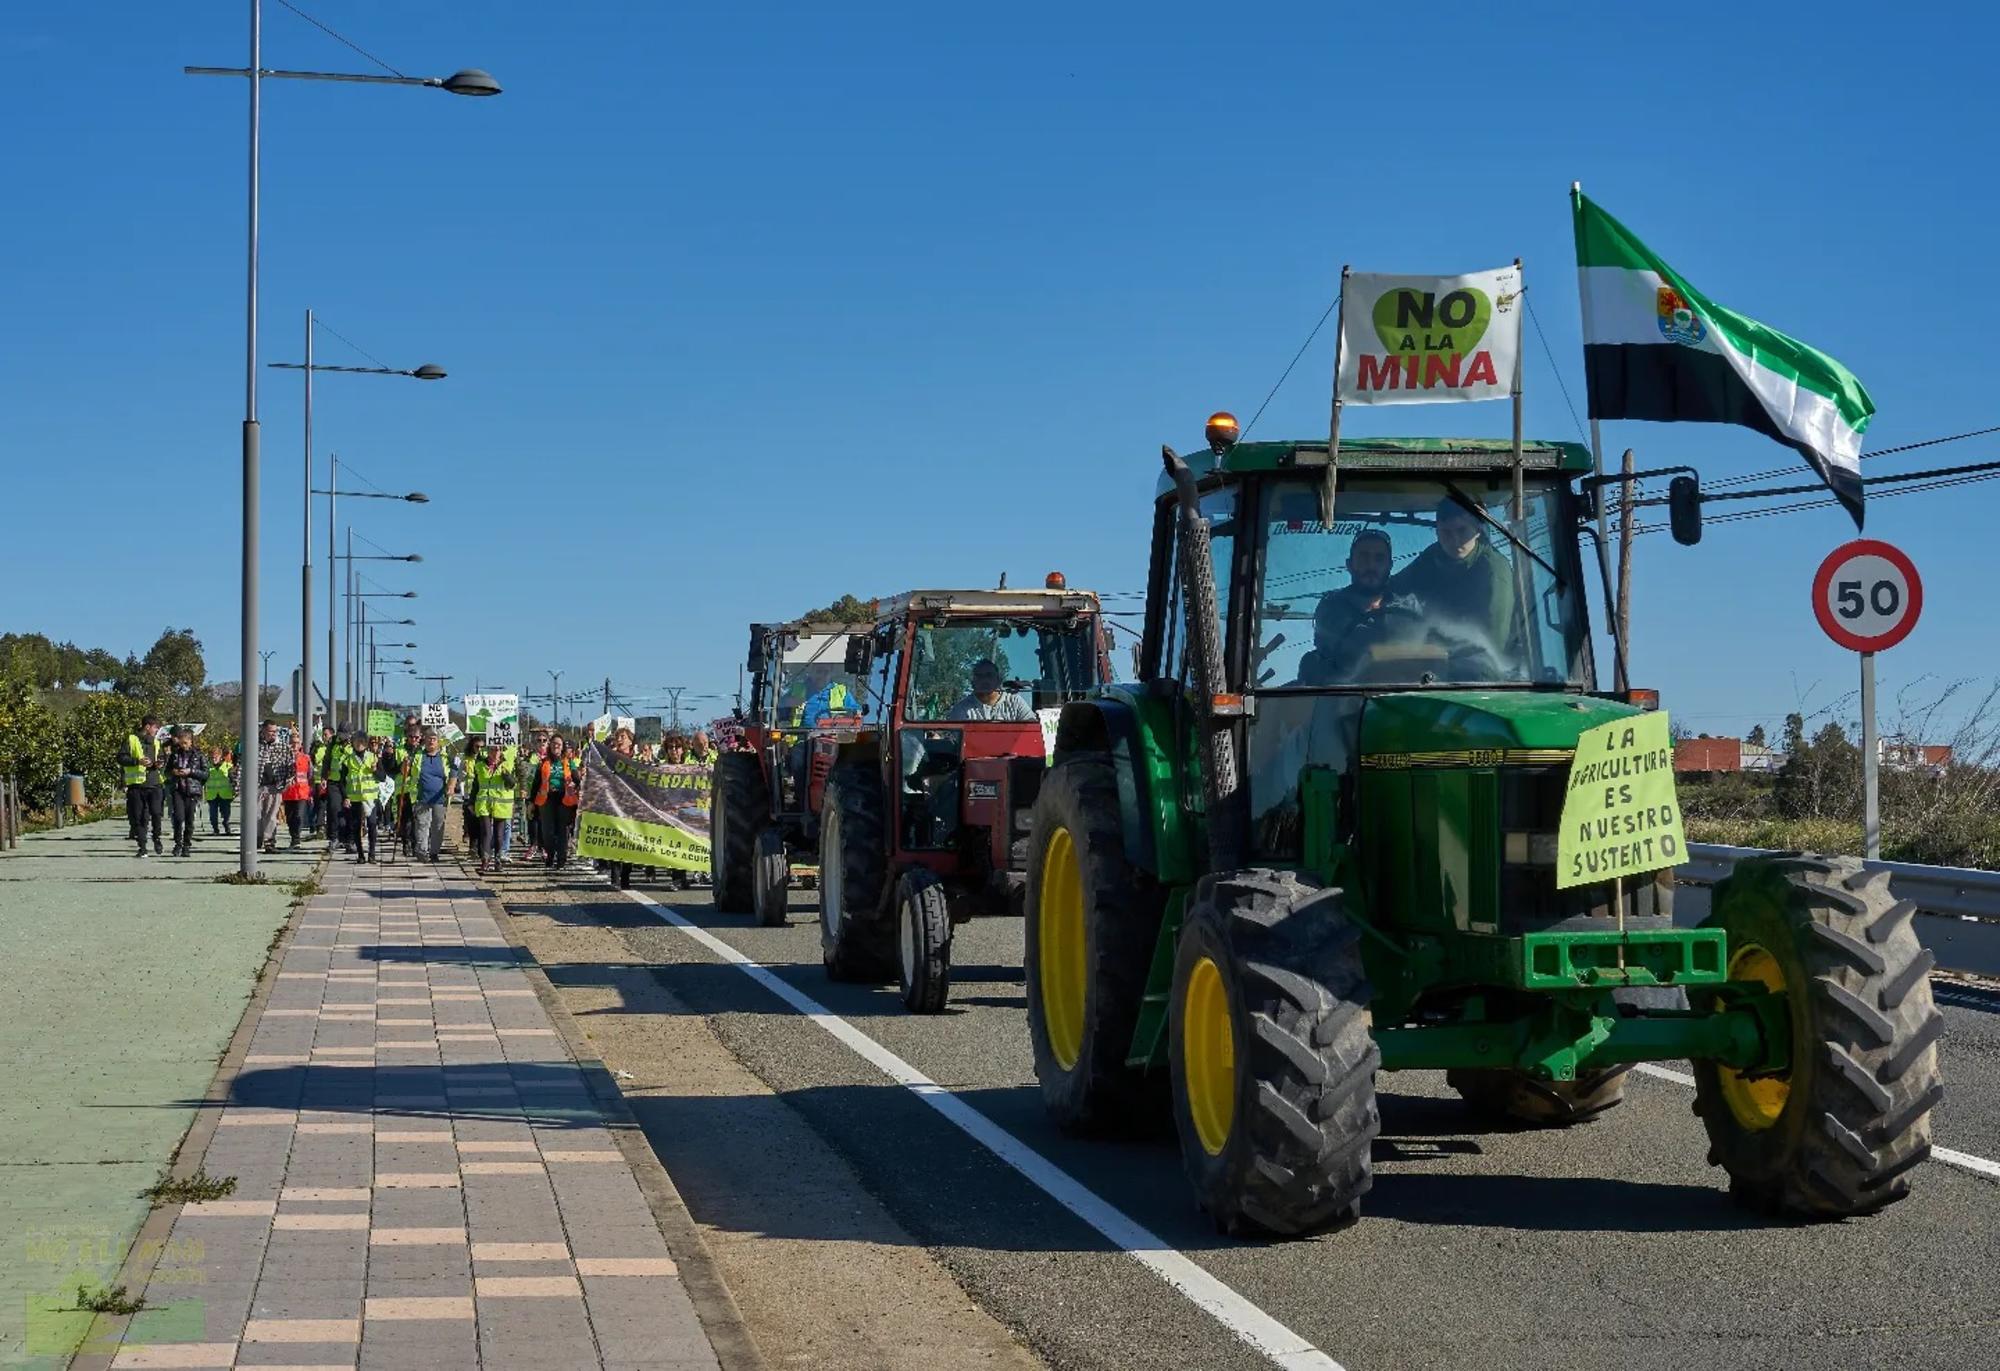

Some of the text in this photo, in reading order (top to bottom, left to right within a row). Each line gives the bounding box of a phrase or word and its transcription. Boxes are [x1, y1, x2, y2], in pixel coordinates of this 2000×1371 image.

[1396, 290, 1476, 329] NO
[1398, 334, 1454, 351] A LA
[1356, 350, 1497, 391] MINA
[1838, 580, 1899, 619] 50
[494, 722, 510, 730] NO
[1607, 728, 1634, 751] LA
[1571, 748, 1667, 790] AGRICULTURA
[1605, 785, 1632, 809] ES
[1580, 805, 1673, 842] NUESTRO
[661, 848, 677, 857] LOS
[669, 840, 681, 848] LA
[1573, 834, 1676, 877] SUSTENTO
